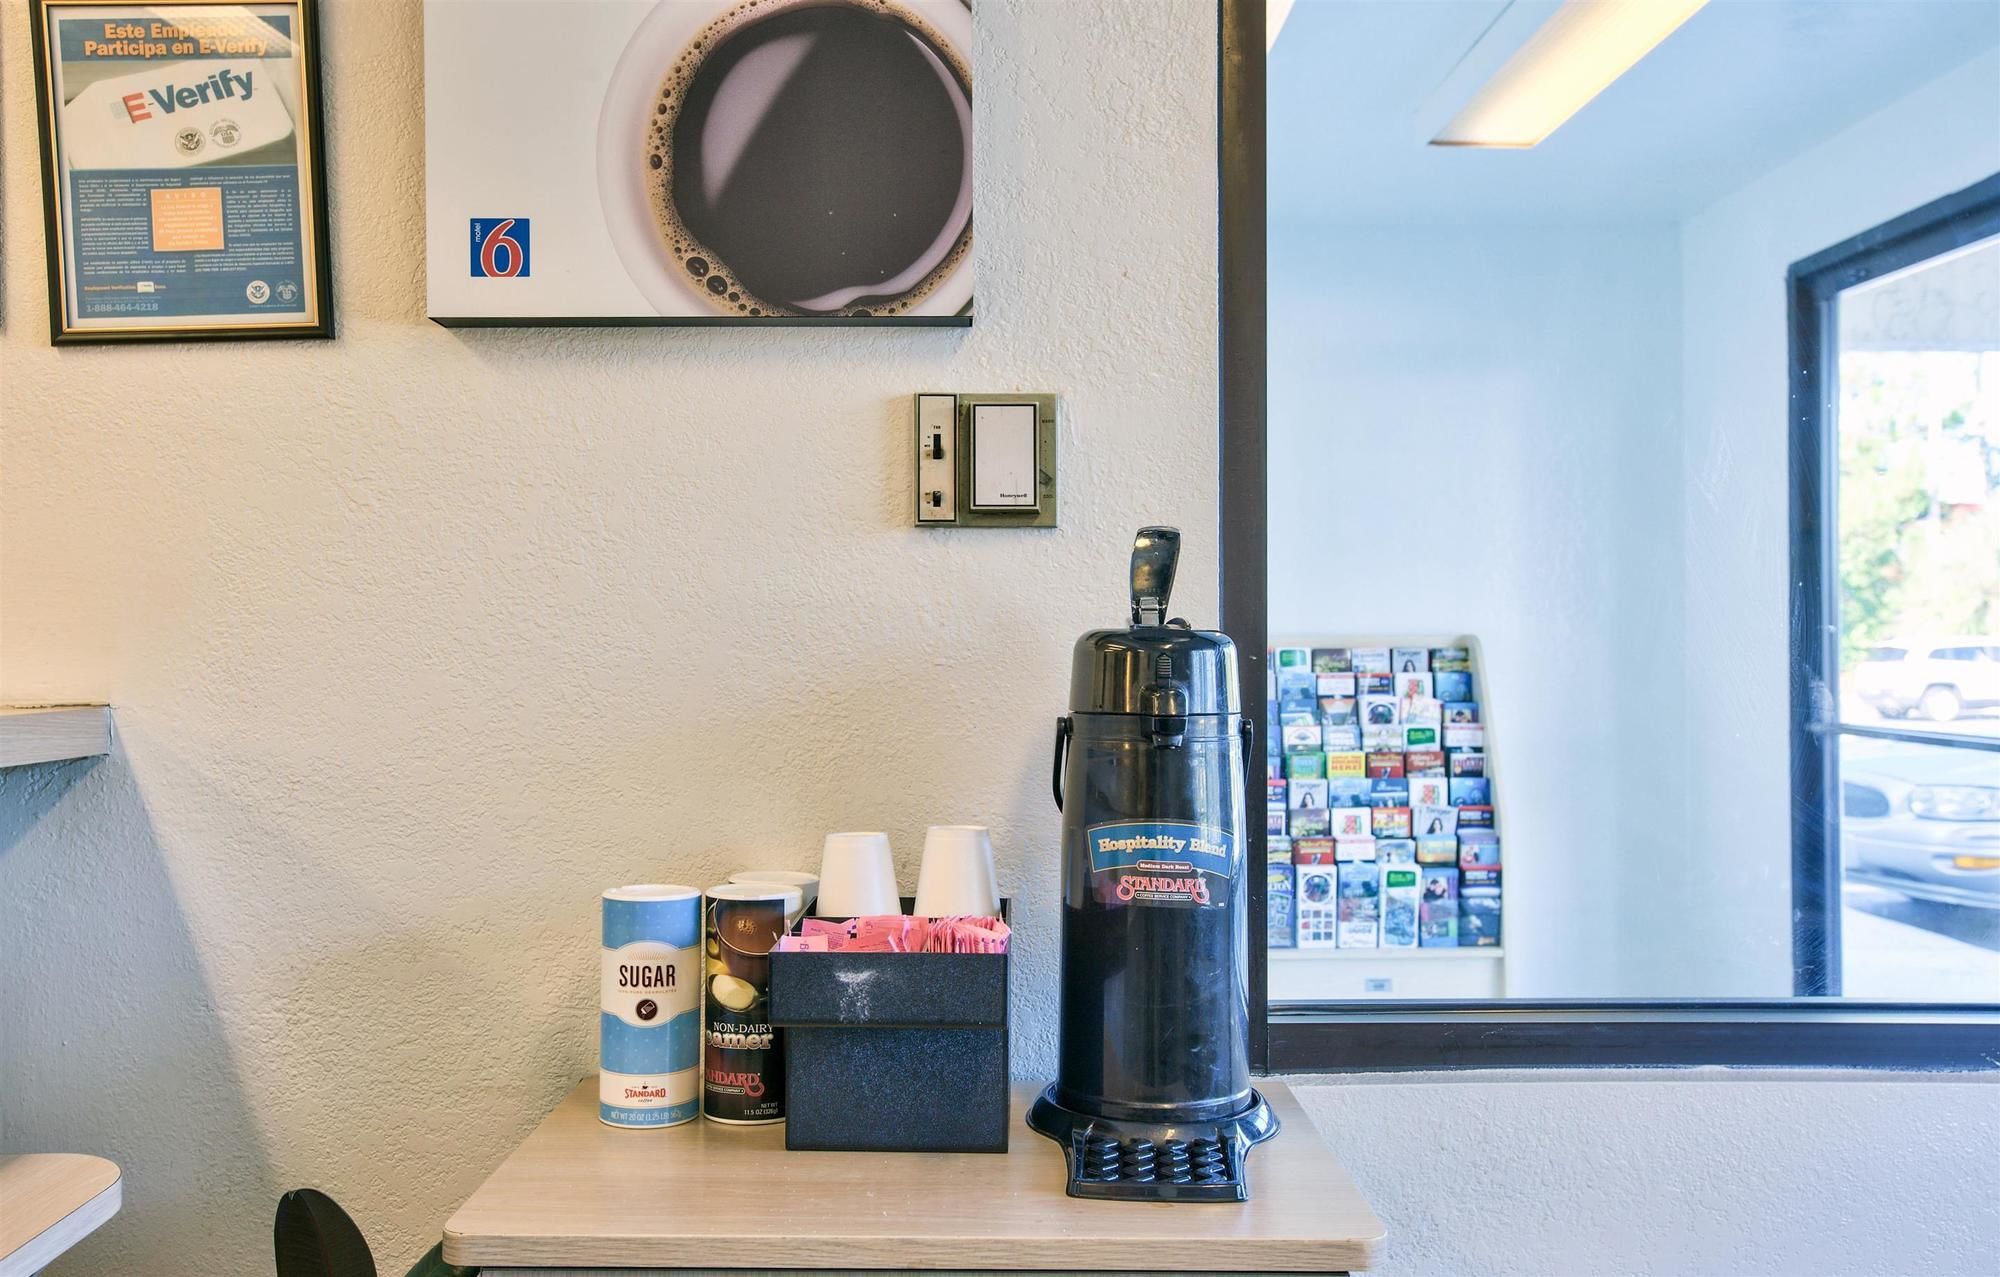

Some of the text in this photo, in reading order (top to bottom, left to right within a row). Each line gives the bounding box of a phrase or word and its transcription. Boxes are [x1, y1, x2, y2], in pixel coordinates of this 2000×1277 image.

[104, 23, 145, 38] Este
[84, 38, 267, 57] Participa en E-Verify
[122, 68, 253, 124] E-Verify
[480, 218, 523, 279] 6
[1098, 835, 1227, 858] Hospitality Blend
[1116, 875, 1210, 904] STANDARD
[619, 964, 676, 988] SUGAR
[713, 1021, 773, 1033] NON-DAIRY
[624, 1088, 667, 1099] STANDARD
